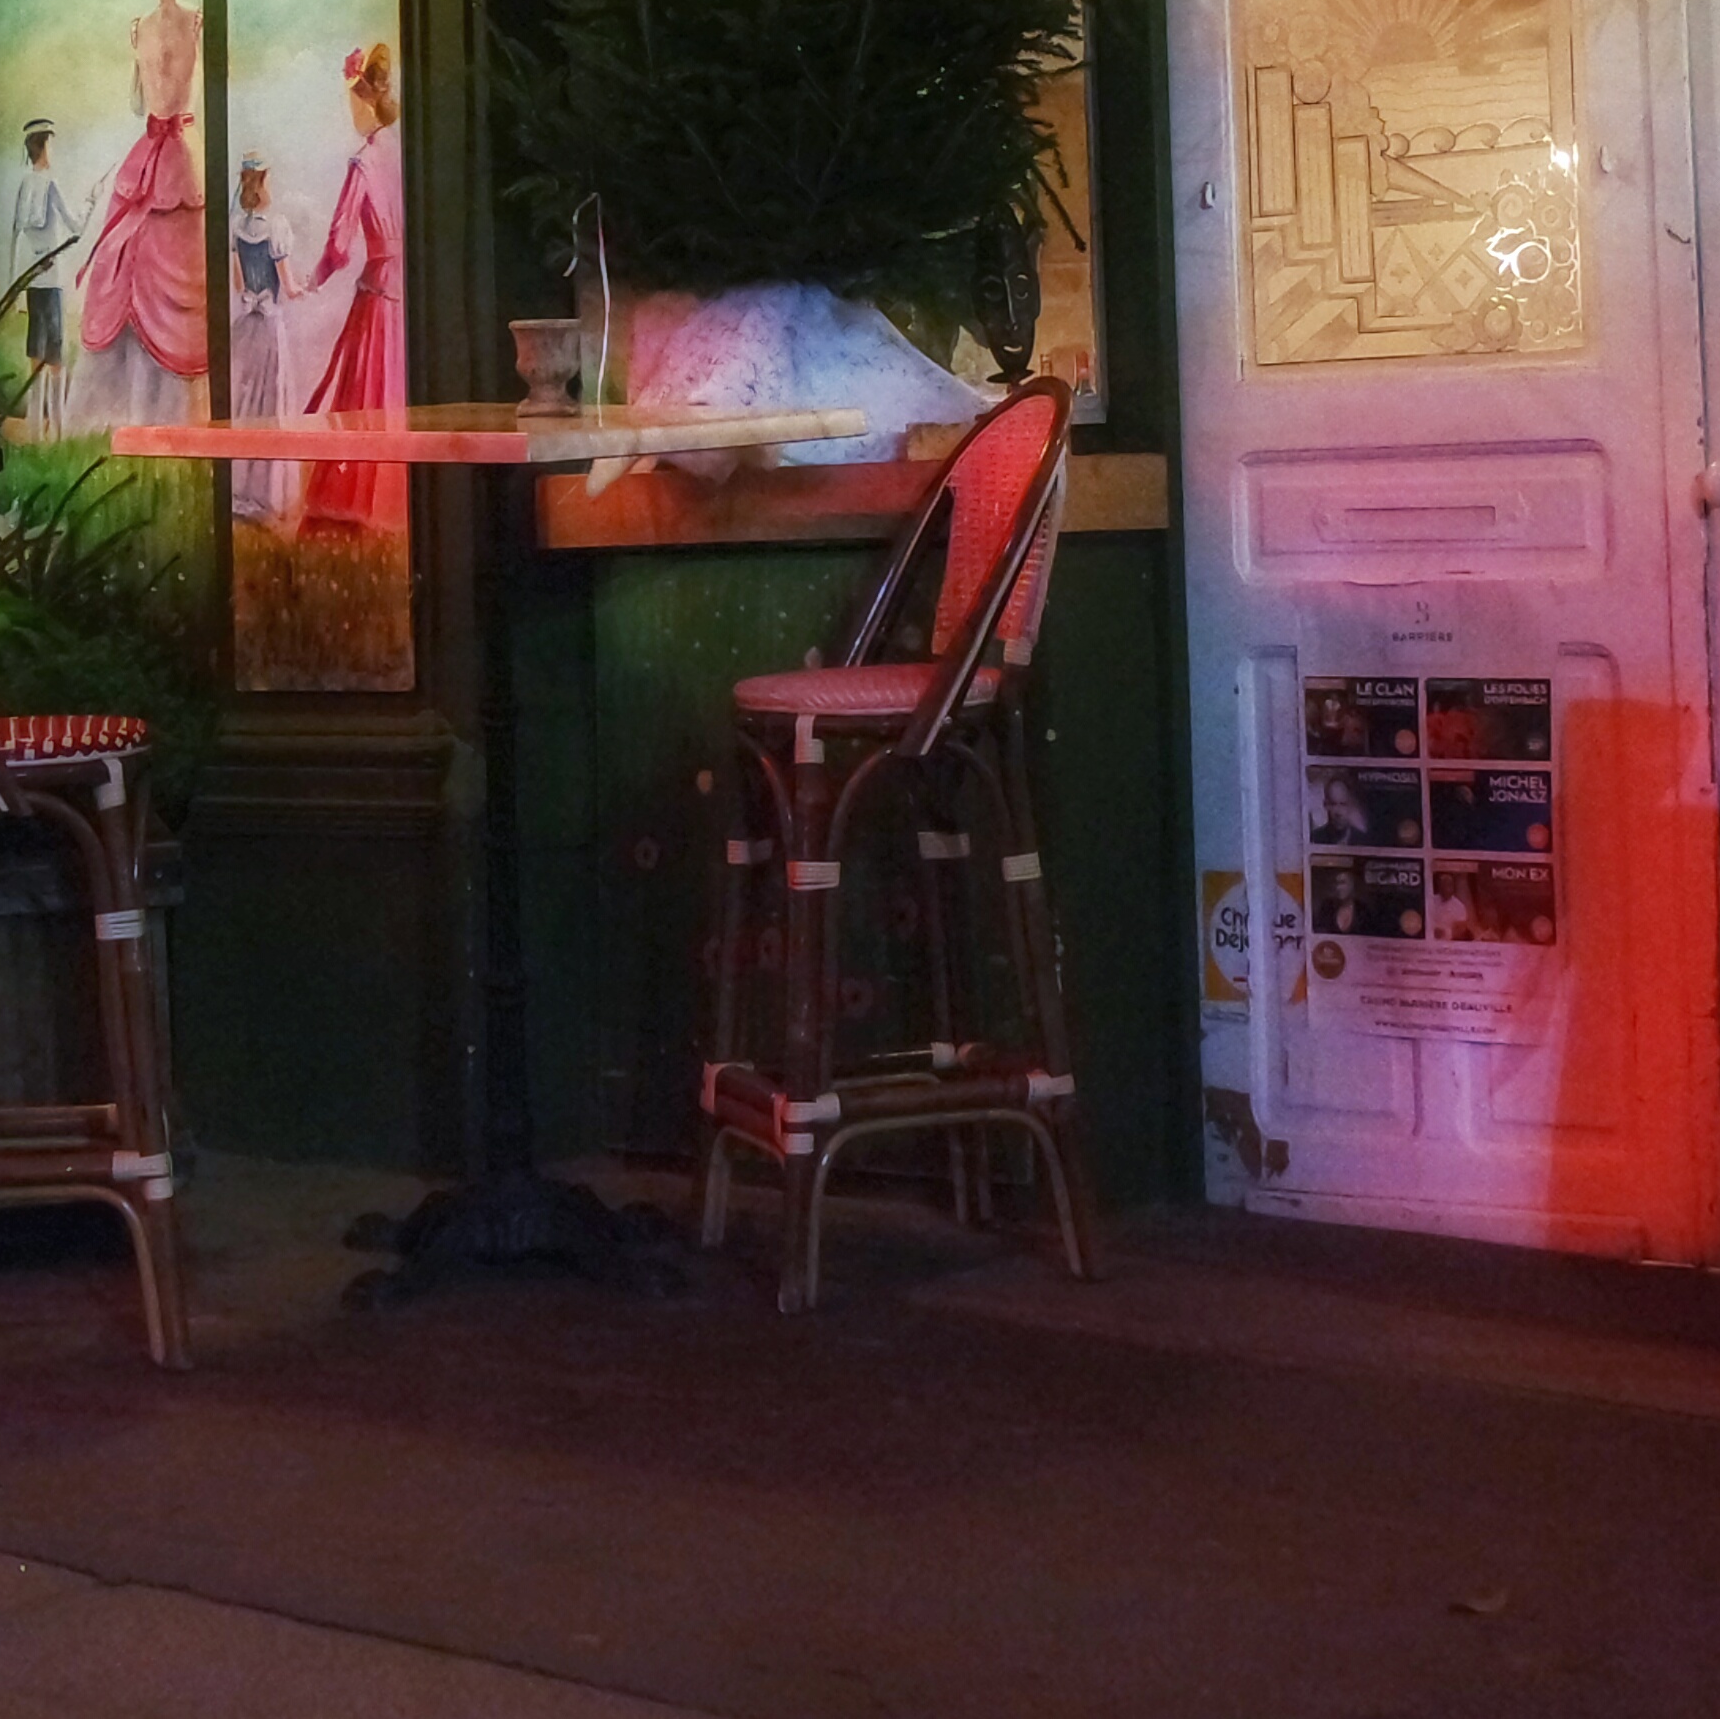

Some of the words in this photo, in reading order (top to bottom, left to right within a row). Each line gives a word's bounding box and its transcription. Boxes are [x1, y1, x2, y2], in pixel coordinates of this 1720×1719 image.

[1489, 776, 1547, 788] MICHEL
[1488, 790, 1547, 803] JONASZ
[1492, 867, 1527, 880] MON
[1529, 868, 1550, 881] EX
